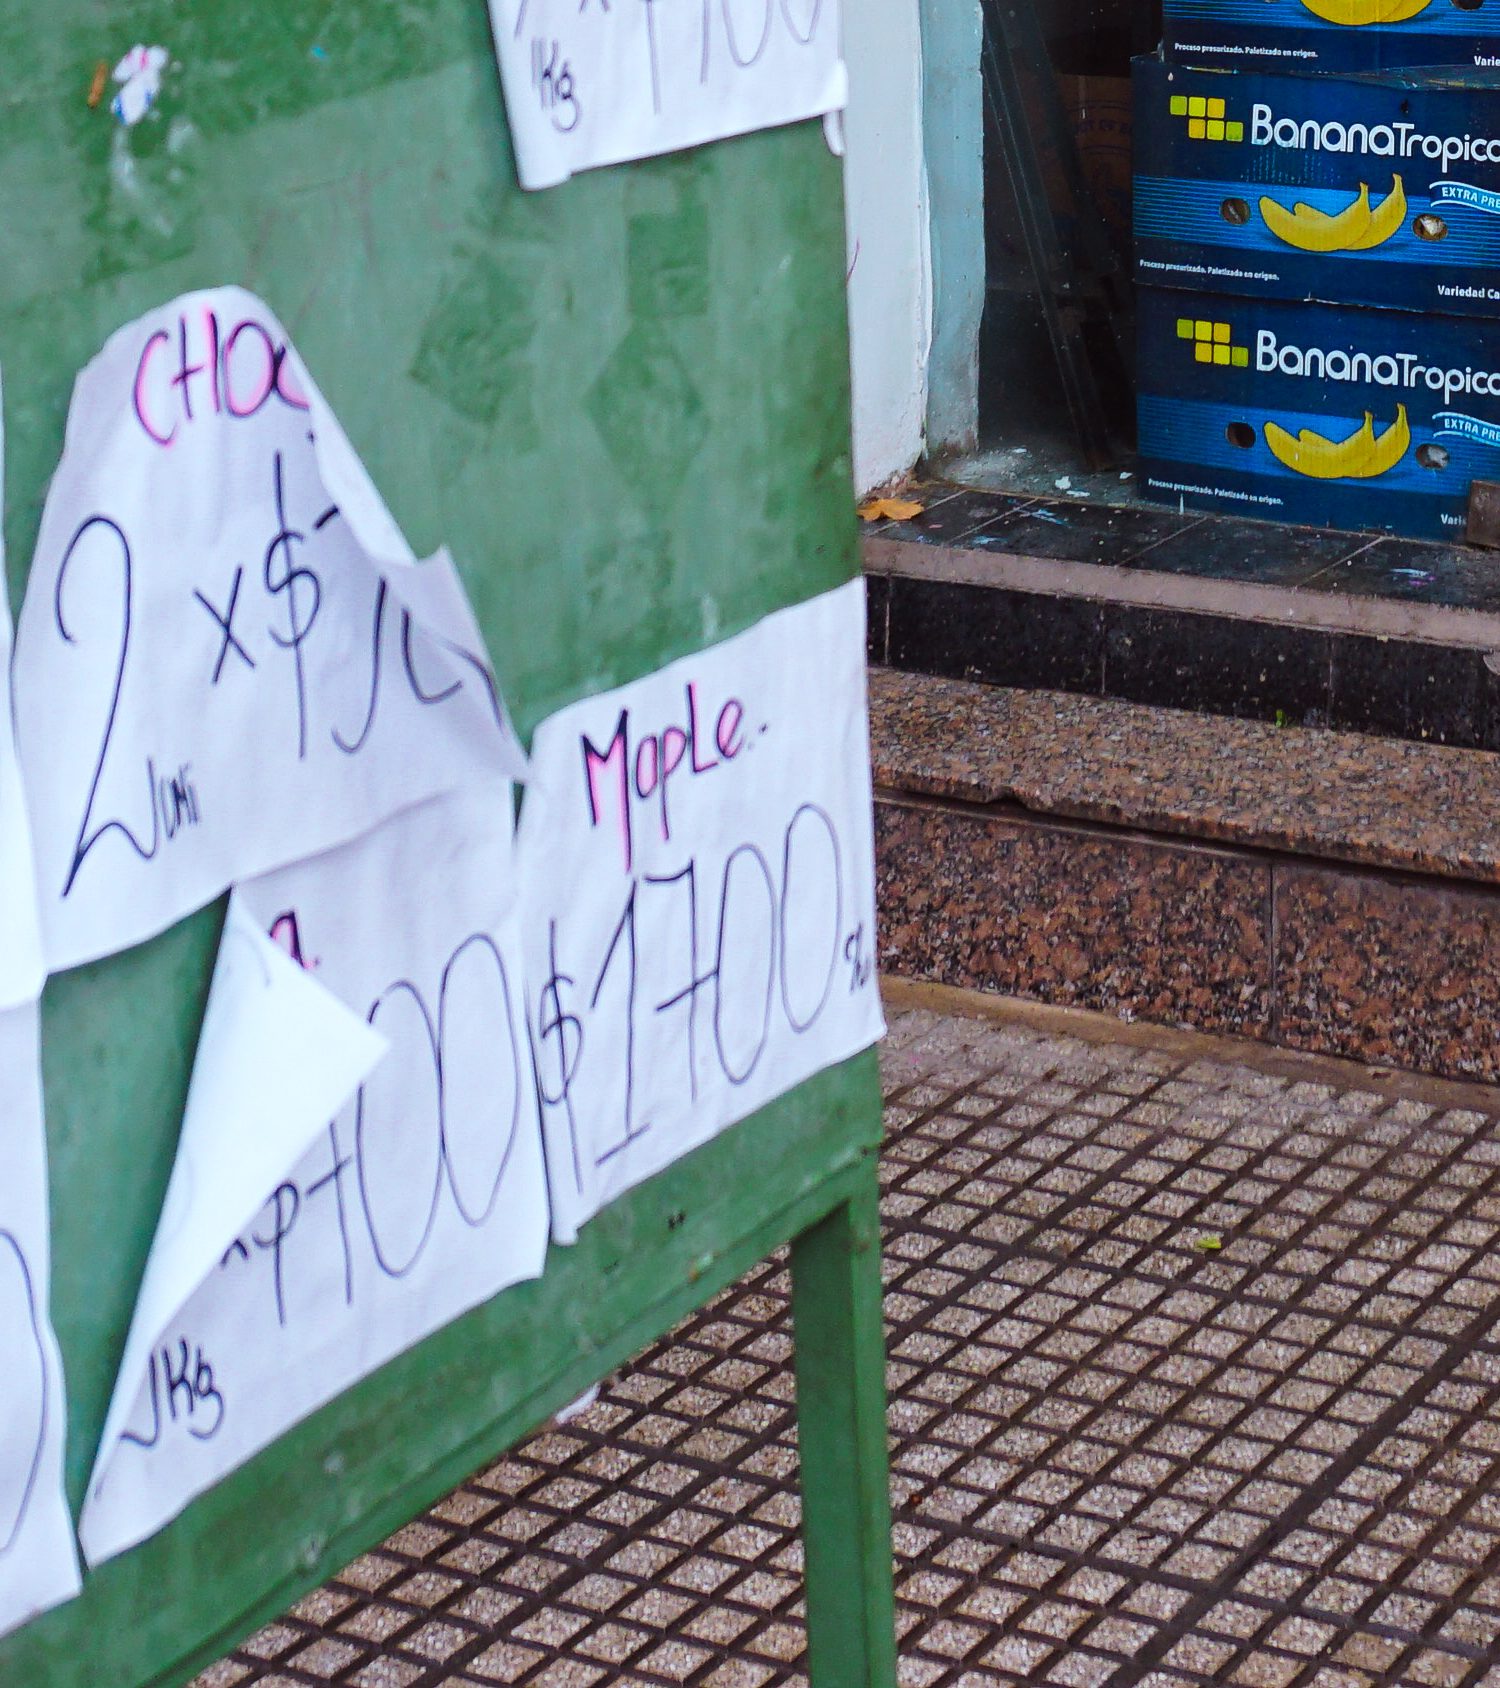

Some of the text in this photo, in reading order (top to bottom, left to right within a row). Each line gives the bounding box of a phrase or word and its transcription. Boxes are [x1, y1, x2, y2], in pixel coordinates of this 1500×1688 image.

[1440, 185, 1479, 203] EXTRA
[1437, 285, 1486, 300] Variedad
[1443, 417, 1479, 435] EXTRA
